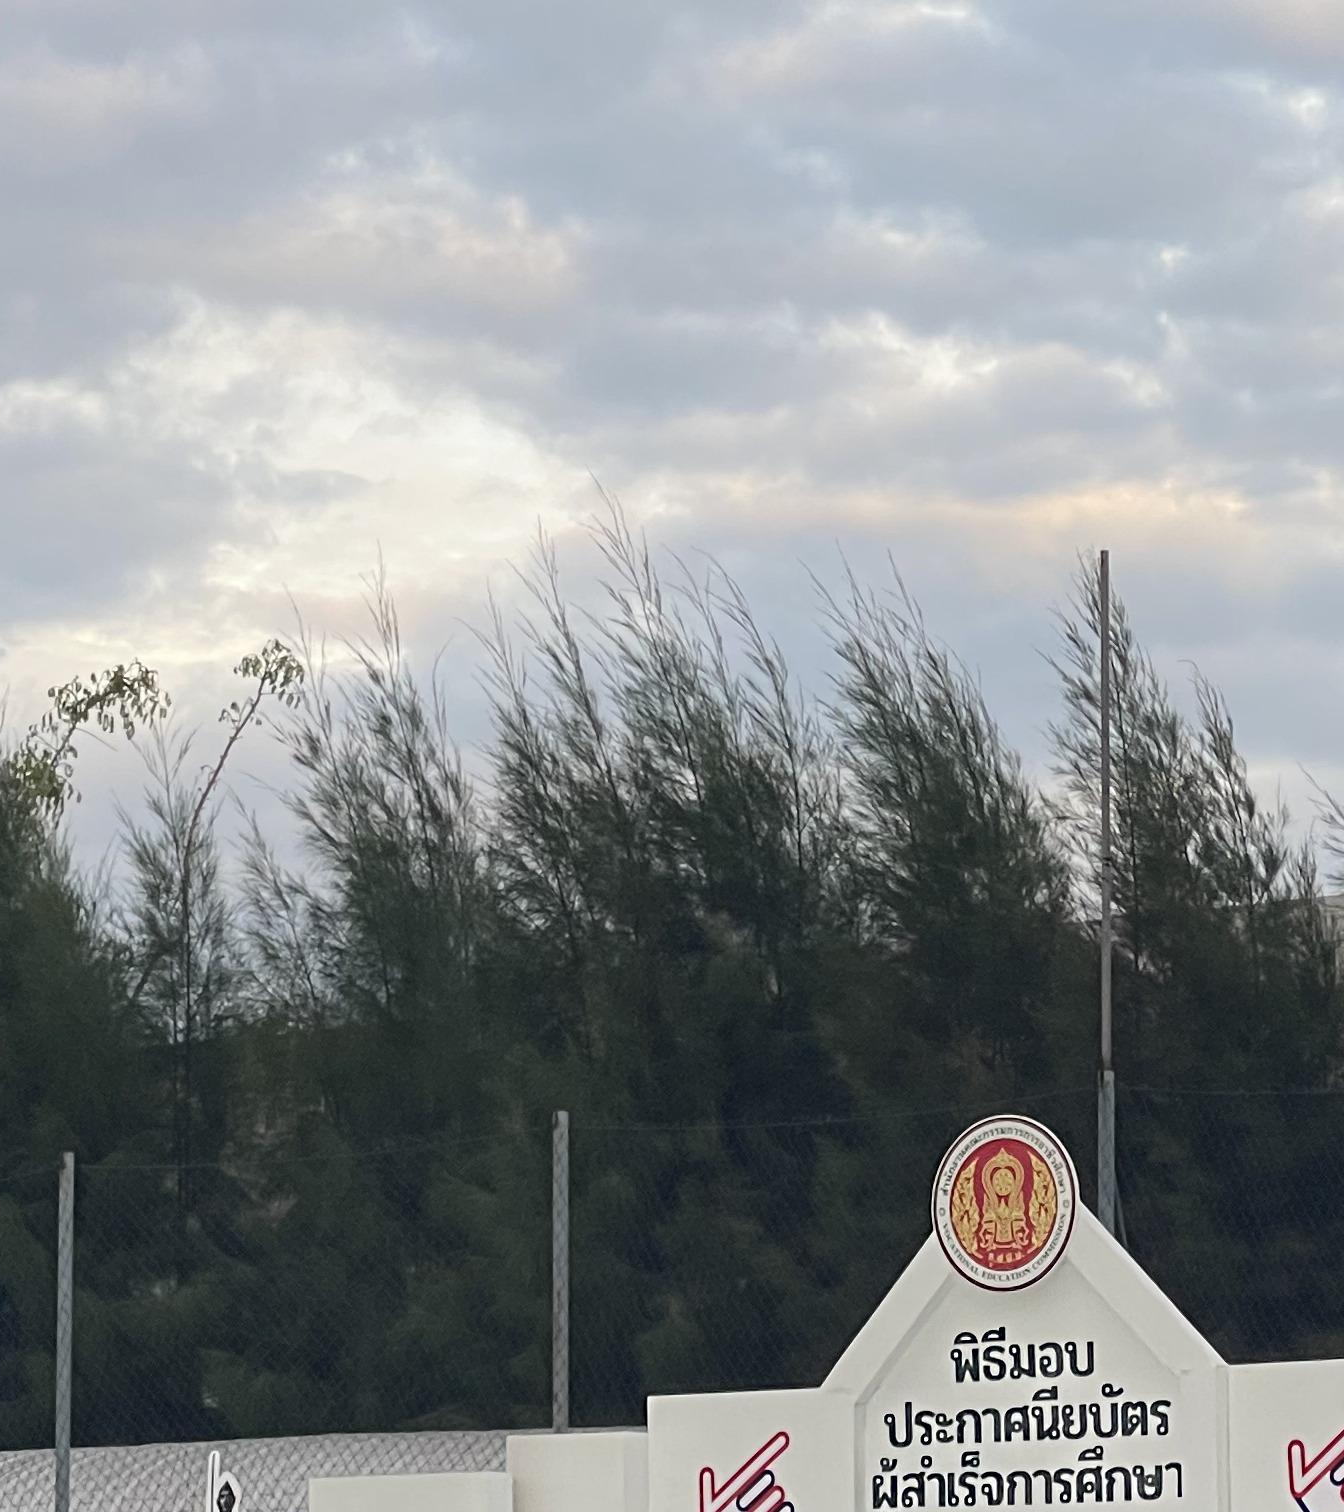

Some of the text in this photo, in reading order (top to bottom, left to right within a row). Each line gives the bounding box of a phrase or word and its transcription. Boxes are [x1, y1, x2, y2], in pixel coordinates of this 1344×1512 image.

[942, 1213, 1066, 1282] VOCATIONAL EDUCATION COMMISSION
[951, 1327, 1095, 1383] พิธีมอบ
[884, 1383, 1172, 1448] ประกาศนียบัตร
